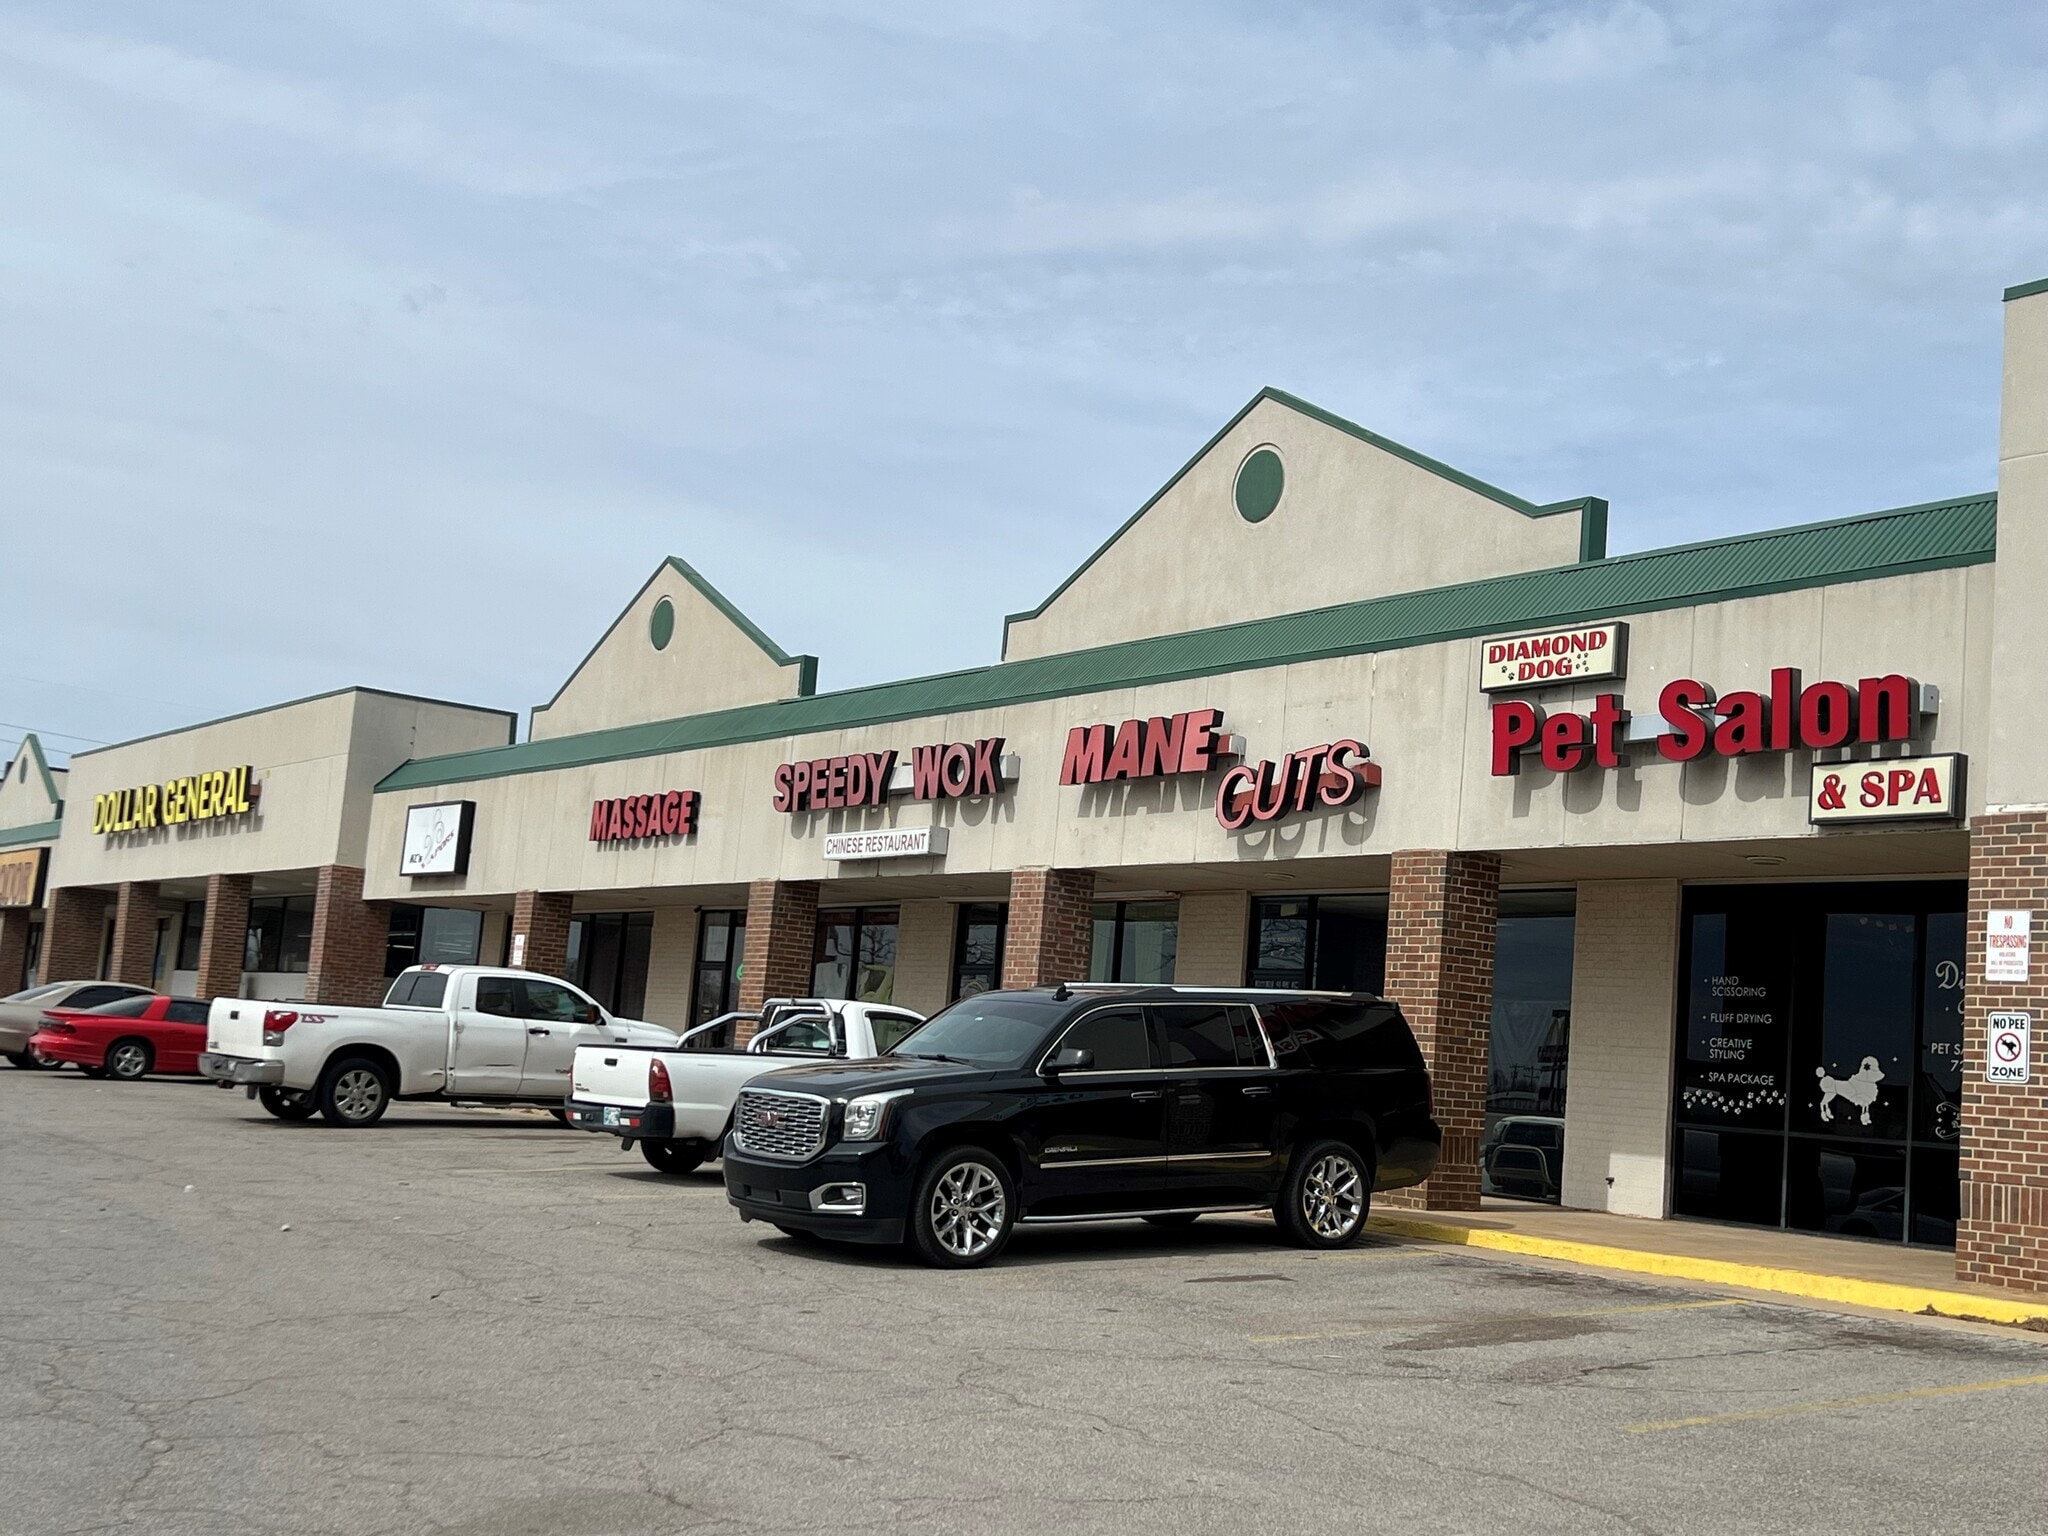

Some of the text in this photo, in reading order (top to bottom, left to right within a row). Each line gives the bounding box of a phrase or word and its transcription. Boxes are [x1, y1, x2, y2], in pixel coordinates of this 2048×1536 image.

[1489, 630, 1607, 663] DIAMOND
[1518, 657, 1572, 681] DOG
[1492, 667, 1919, 776] Pet Salon
[1059, 708, 1224, 785] MANE
[773, 738, 1005, 812] SPEEDY WOK
[1216, 739, 1370, 829] CUTS
[1817, 767, 1942, 810] & SPA
[93, 765, 252, 834] DOLLAR GENERAL
[589, 790, 701, 841] MASSAGE
[826, 832, 927, 855] CHINESE RESTAURANT
[2003, 915, 2013, 930] NO
[1989, 934, 2027, 949] TRESPASSING
[1711, 976, 1739, 986] HAND
[1712, 987, 1766, 997] SCISSORING
[1710, 1013, 1772, 1024] FLUFF DRYING
[1992, 1018, 2025, 1030] NO PEE
[1709, 1038, 1753, 1049] CREATIVE
[1931, 1043, 1950, 1054] PET
[1709, 1049, 1745, 1060] STYLING
[1708, 1072, 1775, 1086] SPA PACKAGE
[1991, 1067, 2025, 1078] ZONE
